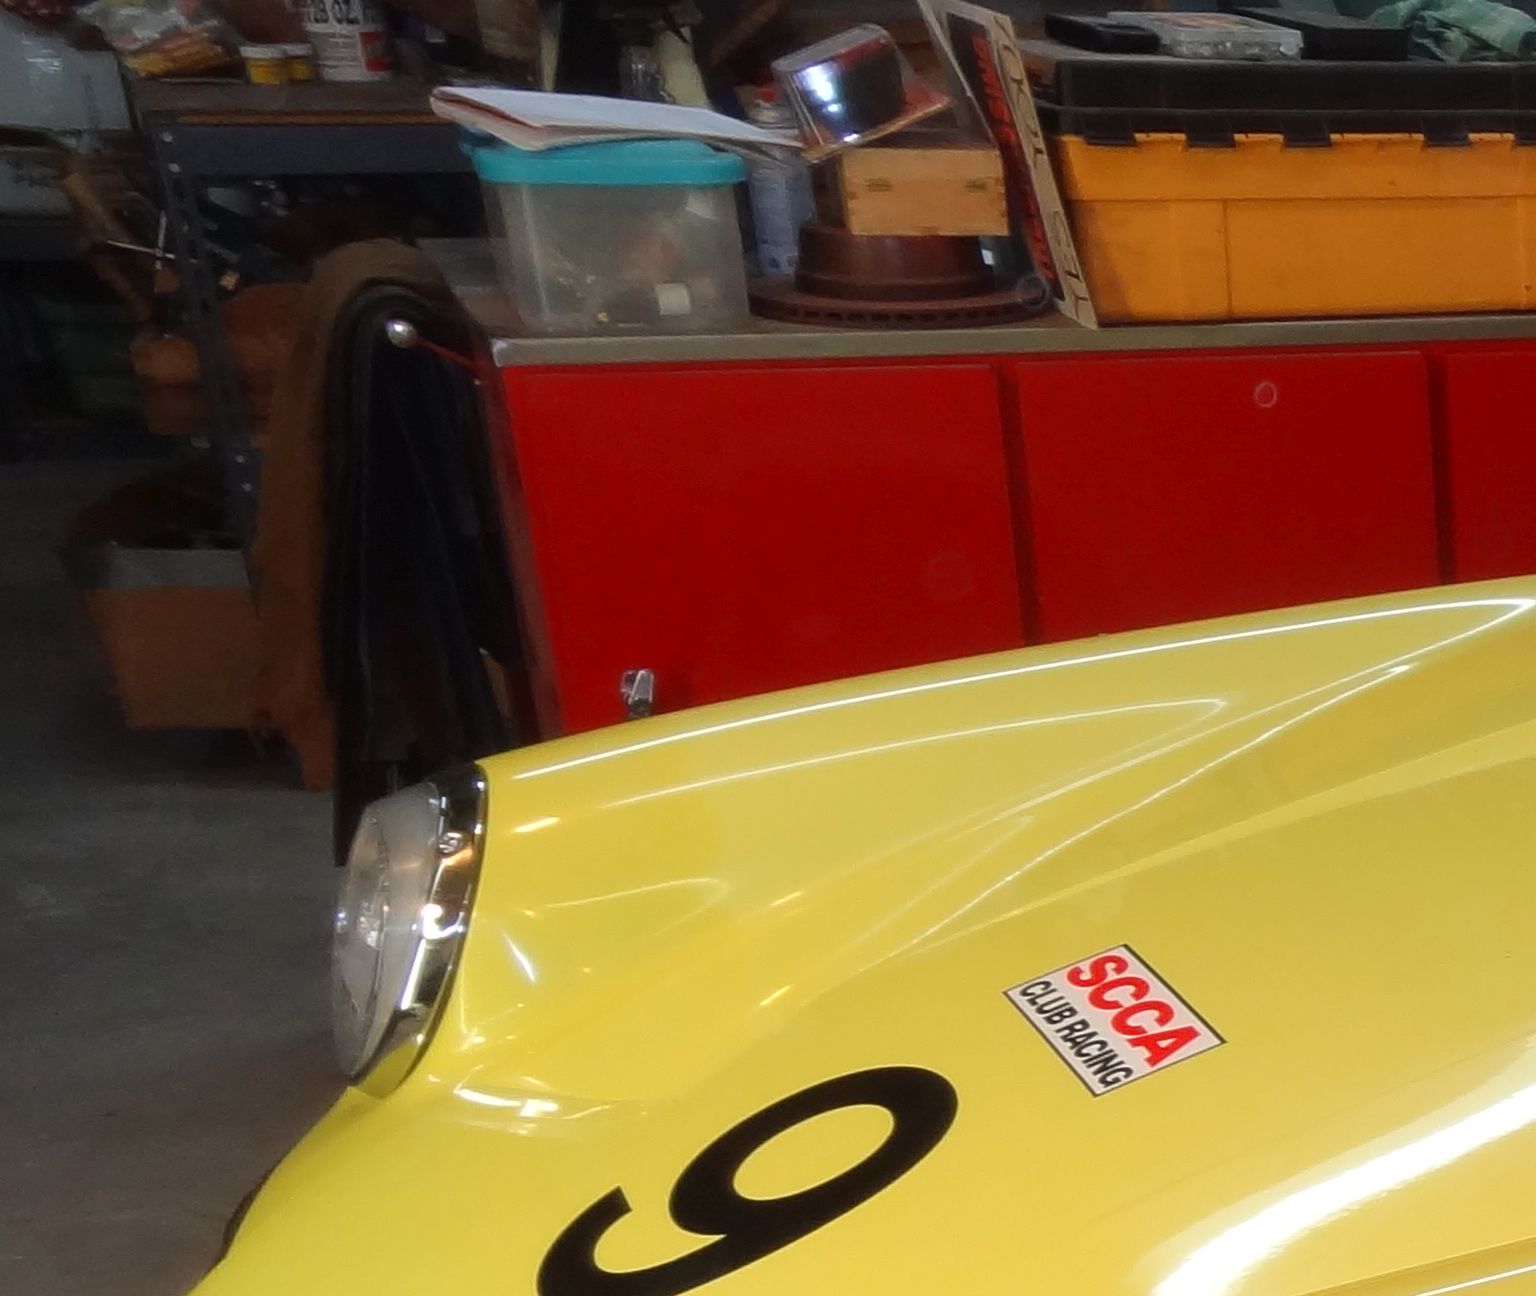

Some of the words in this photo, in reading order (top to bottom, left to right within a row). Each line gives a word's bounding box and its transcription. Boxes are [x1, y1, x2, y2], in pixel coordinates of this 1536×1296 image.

[1019, 980, 1078, 1026] CLUB
[1054, 1018, 1134, 1089] RACING
[1066, 954, 1202, 1069] SCCA
